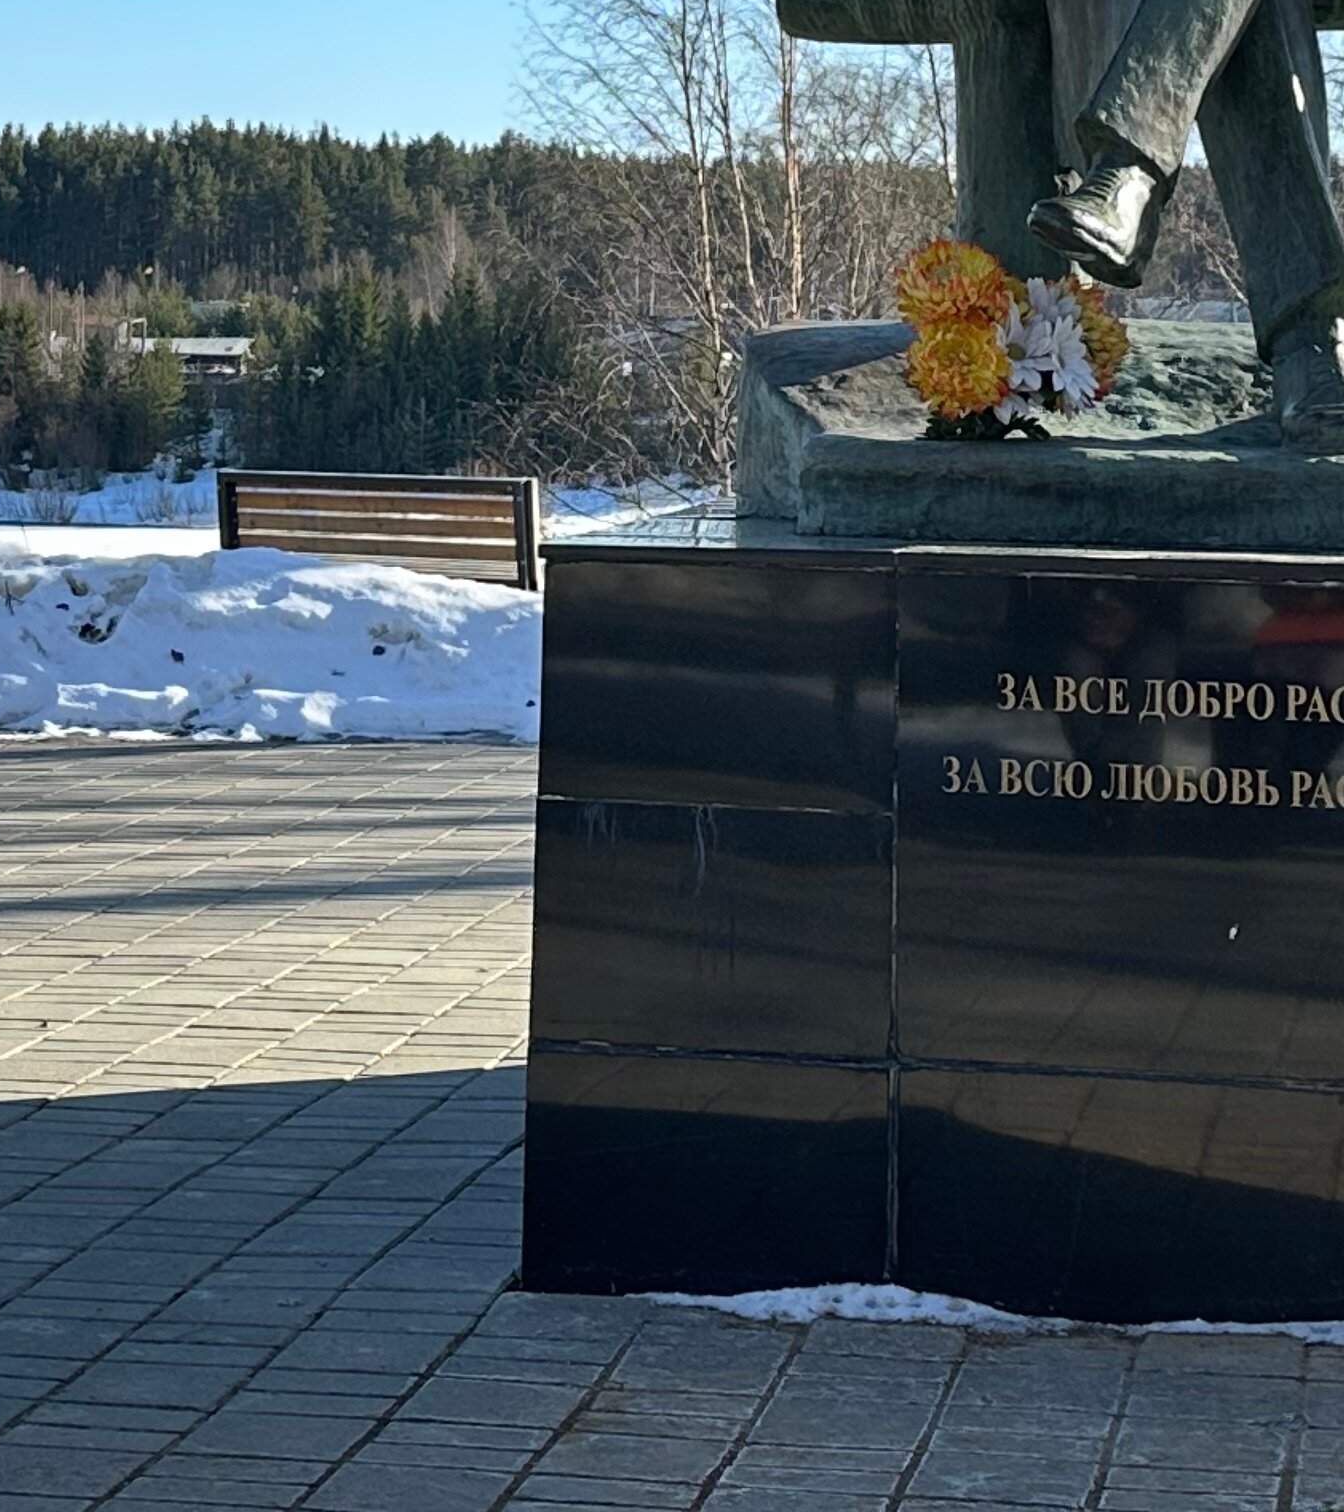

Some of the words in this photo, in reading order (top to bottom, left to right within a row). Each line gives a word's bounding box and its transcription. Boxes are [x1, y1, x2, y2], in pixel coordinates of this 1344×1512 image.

[996, 672, 1044, 713] ЗА
[1053, 675, 1130, 716] ВСЕ
[1138, 679, 1275, 725] ДОБРО
[940, 755, 989, 795] ЗА
[998, 758, 1093, 800] ВСЮ
[1100, 762, 1281, 807] ЛЮБОВЬ
